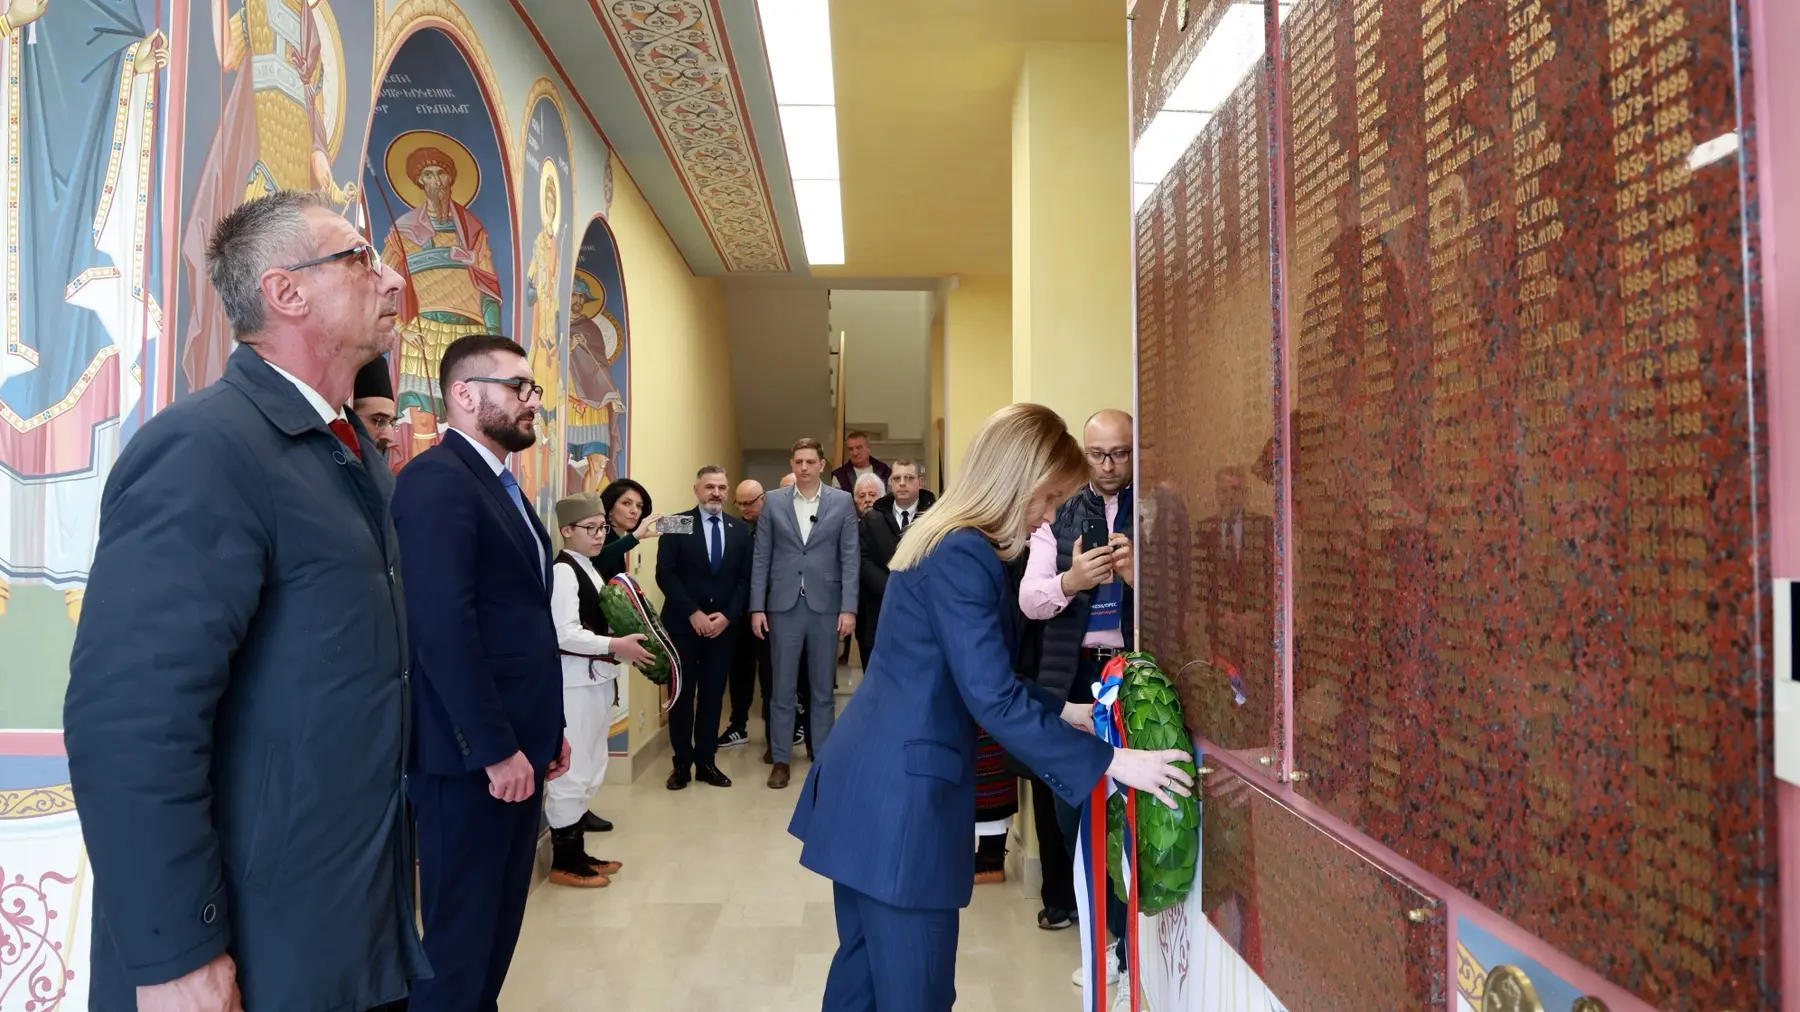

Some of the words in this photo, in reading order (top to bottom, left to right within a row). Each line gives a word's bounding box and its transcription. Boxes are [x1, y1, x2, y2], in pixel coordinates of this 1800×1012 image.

[1510, 78, 1535, 110] МУП
[1512, 102, 1536, 133] МУП
[1515, 178, 1539, 206] МУП
